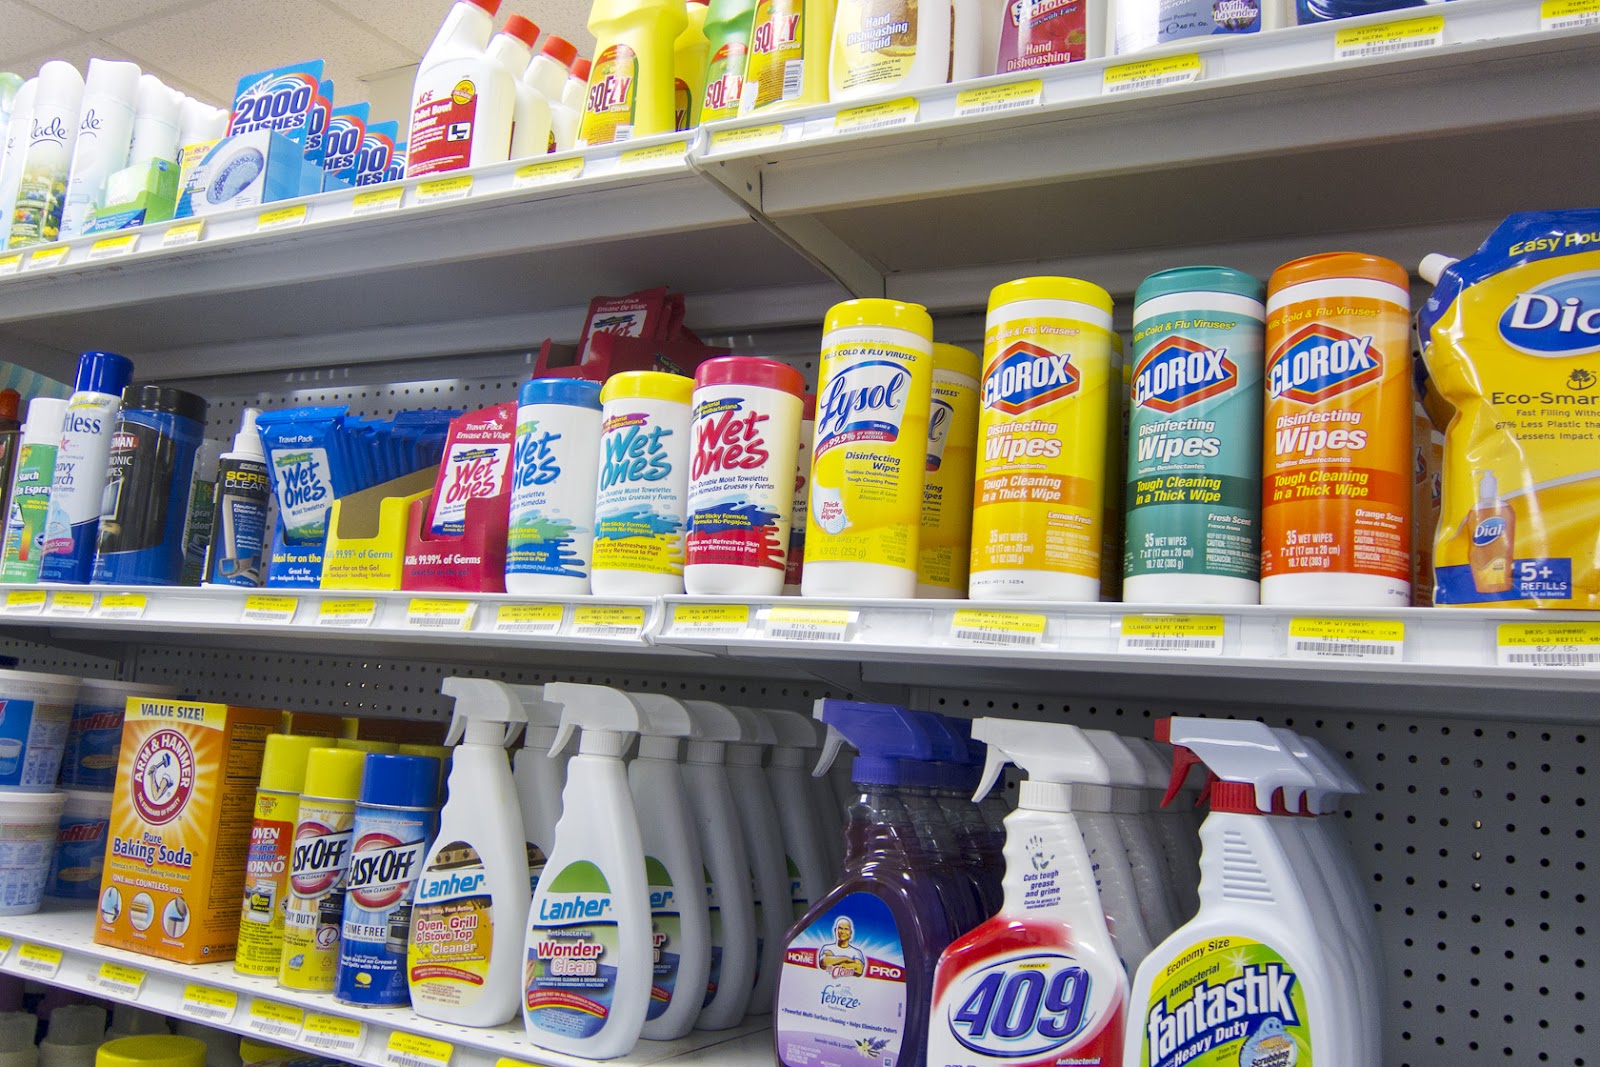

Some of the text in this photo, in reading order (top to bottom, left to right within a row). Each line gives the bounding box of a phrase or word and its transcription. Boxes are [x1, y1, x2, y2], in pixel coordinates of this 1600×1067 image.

[1214, 8, 1258, 20] Lavender
[1220, 1, 1243, 12] With
[865, 12, 891, 29] Hand
[754, 15, 799, 54] SQEZY
[847, 21, 908, 46] Dishwashing
[860, 35, 891, 53] Liquid
[1026, 41, 1052, 55] Hand
[1007, 52, 1071, 71] Dishwashing
[587, 75, 632, 114] SQEZY
[233, 86, 311, 126] 2000
[30, 117, 67, 139] lade
[1509, 231, 1600, 257] Easy Pou
[1282, 311, 1303, 324] Cold
[1305, 309, 1312, 318] &
[1316, 307, 1333, 317] Flu
[1145, 324, 1164, 336] Cold
[1174, 320, 1191, 330] Flu
[838, 349, 858, 357] COLD
[1270, 336, 1373, 400] CLOROX
[984, 354, 1071, 410] CLOROX
[1135, 348, 1226, 409] CLOROX
[818, 372, 905, 435] Lysol
[1492, 392, 1600, 405] Eco-Smar
[1276, 409, 1362, 430] Disinfecting
[1516, 409, 1570, 418] Fast Filling
[465, 423, 486, 431] Travel
[697, 410, 770, 450] Wet
[986, 420, 1058, 437] Disinfecting
[1138, 418, 1216, 437] Disinfecting
[1495, 420, 1600, 430] 67% Less Plastic tha
[492, 432, 511, 440] Viaje
[606, 425, 673, 463] Wet
[1275, 426, 1368, 457] Wipes
[1516, 432, 1593, 441] Lessens Impact
[985, 434, 1062, 463] Wipes
[1138, 434, 1221, 463] Wipes
[692, 438, 769, 481] Ones
[845, 451, 901, 466] Disinfecting
[55, 462, 75, 474] eavy
[282, 462, 320, 487] Wet
[456, 458, 500, 484] Wet
[600, 451, 672, 491] Ones
[872, 462, 900, 473] Wipes
[983, 475, 1062, 490] Tough Cleaning
[1137, 476, 1221, 492] Tough Cleaning
[1274, 470, 1369, 488] Tough Cleaning
[284, 480, 326, 509] Ones
[446, 476, 495, 504] Ones
[923, 491, 943, 500] ipes
[999, 488, 1061, 501] Thick Wipe
[1154, 489, 1221, 503] Thick Wipe
[1273, 484, 1368, 501] in a Thick Wipe
[1208, 513, 1231, 523] Fresh
[1355, 508, 1403, 523] Orange Scent
[1286, 530, 1333, 545] 35 WET WIPES
[1474, 525, 1502, 538] Dial
[1145, 533, 1188, 548] 35 WIPES
[287, 553, 297, 563] for
[308, 554, 321, 563] the
[358, 550, 366, 558] of
[368, 549, 393, 558] Germs
[418, 554, 442, 565] 99.99%
[444, 554, 453, 565] of
[455, 554, 481, 565] Germs
[1520, 562, 1553, 582] 5+
[1520, 582, 1568, 591] REFILLS
[71, 710, 125, 732] mpRid
[141, 703, 205, 722] VALUE SIZE!
[135, 746, 152, 782] ARM
[151, 739, 160, 752] &
[161, 734, 191, 788] HAMMER
[143, 831, 163, 844] Pure
[252, 828, 280, 839] OVEN
[113, 837, 193, 867] Baking Soda
[1040, 870, 1059, 879] tough
[136, 878, 169, 891] COUNTLESS
[420, 873, 485, 899] Lanher
[1025, 888, 1060, 897] and grime
[1031, 880, 1054, 890] grease
[540, 895, 611, 921] Lanher
[296, 913, 316, 925] DUTY
[417, 915, 477, 932] Oven, Grill
[364, 926, 386, 937] FREE
[425, 929, 473, 941] Stove Top
[432, 943, 477, 955] Cleaner
[538, 941, 601, 958] Wonder
[1167, 938, 1230, 977] Economy Size
[788, 952, 814, 964] HOME
[552, 959, 596, 975] Clean
[870, 966, 901, 978] PRO
[1169, 962, 1220, 999] Antibacterial
[821, 984, 858, 1009] febreze
[953, 966, 1090, 1040] 409
[1147, 963, 1296, 1067] fantastik
[862, 1022, 882, 1033] Eliminate
[883, 1025, 897, 1035] Odors
[1174, 1020, 1249, 1067] Heavy Duty
[1056, 1057, 1101, 1066] Antibacterial
